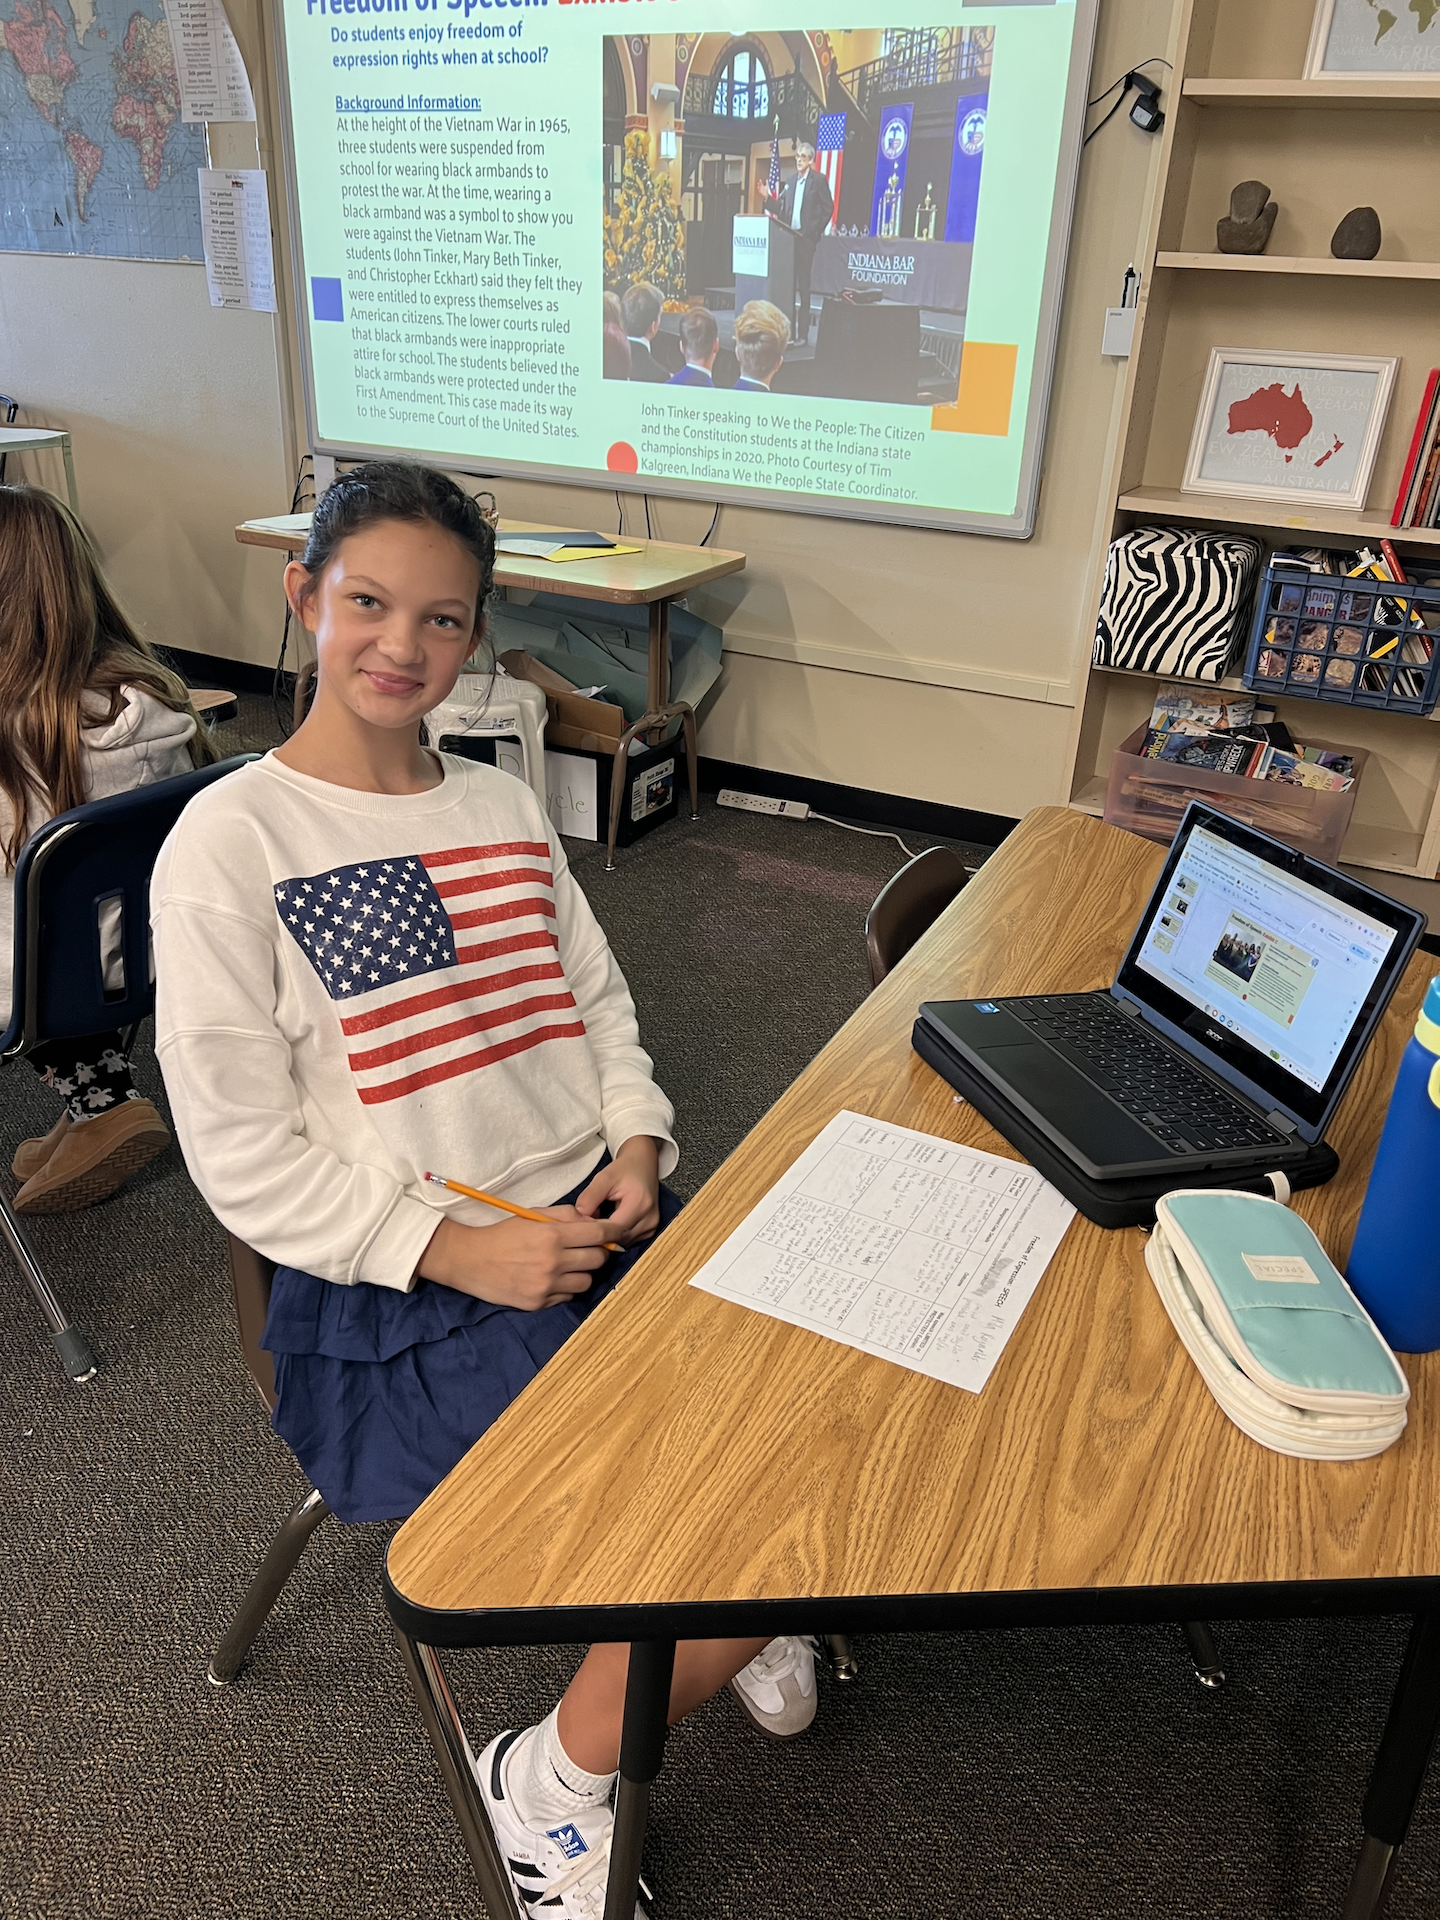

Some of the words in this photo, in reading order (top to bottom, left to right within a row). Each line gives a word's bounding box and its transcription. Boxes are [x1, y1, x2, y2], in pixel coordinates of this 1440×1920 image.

[307, 0, 408, 15] Freedom
[331, 26, 348, 43] Do
[351, 25, 405, 42] students
[409, 23, 444, 43] enjoy
[448, 21, 505, 39] freedom
[509, 20, 523, 38] of
[333, 50, 398, 71] expression
[402, 49, 438, 69] rights
[442, 48, 477, 66] when
[481, 50, 494, 65] at
[497, 46, 549, 64] school?
[335, 94, 404, 113] Background
[407, 94, 481, 109] Information:
[336, 116, 348, 132] At
[350, 115, 369, 132] the
[371, 115, 407, 135] height
[409, 115, 420, 131] of
[423, 115, 442, 131] the
[444, 115, 494, 132] Vietnam
[496, 116, 521, 132] War
[524, 115, 536, 132] in
[539, 117, 570, 133] 1965,
[341, 183, 379, 200] protest
[380, 182, 399, 198] the
[401, 186, 424, 198] war.
[426, 183, 439, 198] At
[441, 183, 460, 199] the
[462, 183, 492, 201] time,
[493, 185, 541, 205] wearing
[544, 189, 551, 201] a
[343, 227, 370, 240] were
[372, 225, 412, 244] against
[414, 226, 432, 242] the
[434, 227, 482, 244] Vietnam
[483, 229, 511, 245] War.
[512, 230, 535, 246] The
[345, 245, 391, 261] students
[393, 247, 421, 262] (John
[422, 247, 460, 265] Tinker,
[462, 249, 490, 269] Mary
[492, 250, 519, 266] Beth
[521, 251, 561, 270] Tinker,
[848, 252, 891, 270] INDIANA
[893, 255, 915, 271] BAR
[347, 266, 367, 280] and
[369, 266, 431, 286] Christopher
[433, 269, 478, 286] Eckhart)
[480, 272, 503, 287] said
[505, 273, 532, 293] they
[534, 274, 553, 290] felt
[556, 275, 582, 295] they
[851, 271, 908, 285] FOUNDATION
[349, 306, 399, 323] American
[401, 309, 444, 325] citizens.
[445, 311, 467, 327] The
[469, 312, 500, 329] lower
[502, 317, 538, 332] courts
[540, 318, 570, 333] ruled
[353, 346, 380, 361] attire
[381, 347, 396, 362] for
[398, 349, 435, 365] school.
[436, 351, 457, 367] The
[459, 354, 507, 371] students
[509, 356, 557, 375] believed
[560, 361, 579, 376] the
[356, 404, 367, 417] to
[369, 404, 386, 419] the
[388, 405, 435, 423] Supreme
[437, 410, 466, 427] Court
[468, 413, 479, 428] of
[481, 415, 500, 430] the
[502, 417, 539, 434] United
[541, 420, 579, 438] States.
[641, 402, 665, 417] John
[666, 404, 700, 420] Tinker
[702, 410, 751, 429] speaking
[756, 414, 768, 427] to
[770, 414, 790, 429] We
[792, 417, 812, 431] the
[814, 418, 857, 437] People:
[858, 422, 881, 438] The
[884, 425, 924, 441] Citizen
[640, 422, 660, 435] and
[662, 423, 680, 437] the
[682, 424, 747, 444] Constitution
[749, 433, 797, 449] students
[800, 438, 811, 450] at
[814, 438, 833, 453] the
[836, 439, 878, 457] Indiana
[881, 446, 911, 460] state
[640, 456, 689, 475] Kalgreen,
[690, 462, 730, 479] Indiana
[731, 467, 751, 482] We
[753, 469, 772, 484] the
[774, 471, 813, 489] People
[815, 475, 845, 492] State
[847, 479, 917, 499] Coordinator.
[1206, 1028, 1223, 1041] acer
[1025, 1235, 1039, 1254] Freedom
[1004, 1260, 1025, 1286] Expression:
[1254, 1264, 1304, 1273] SPECIAL
[994, 1286, 1010, 1307] SPEECH
[919, 1332, 931, 1347] LIMITED
